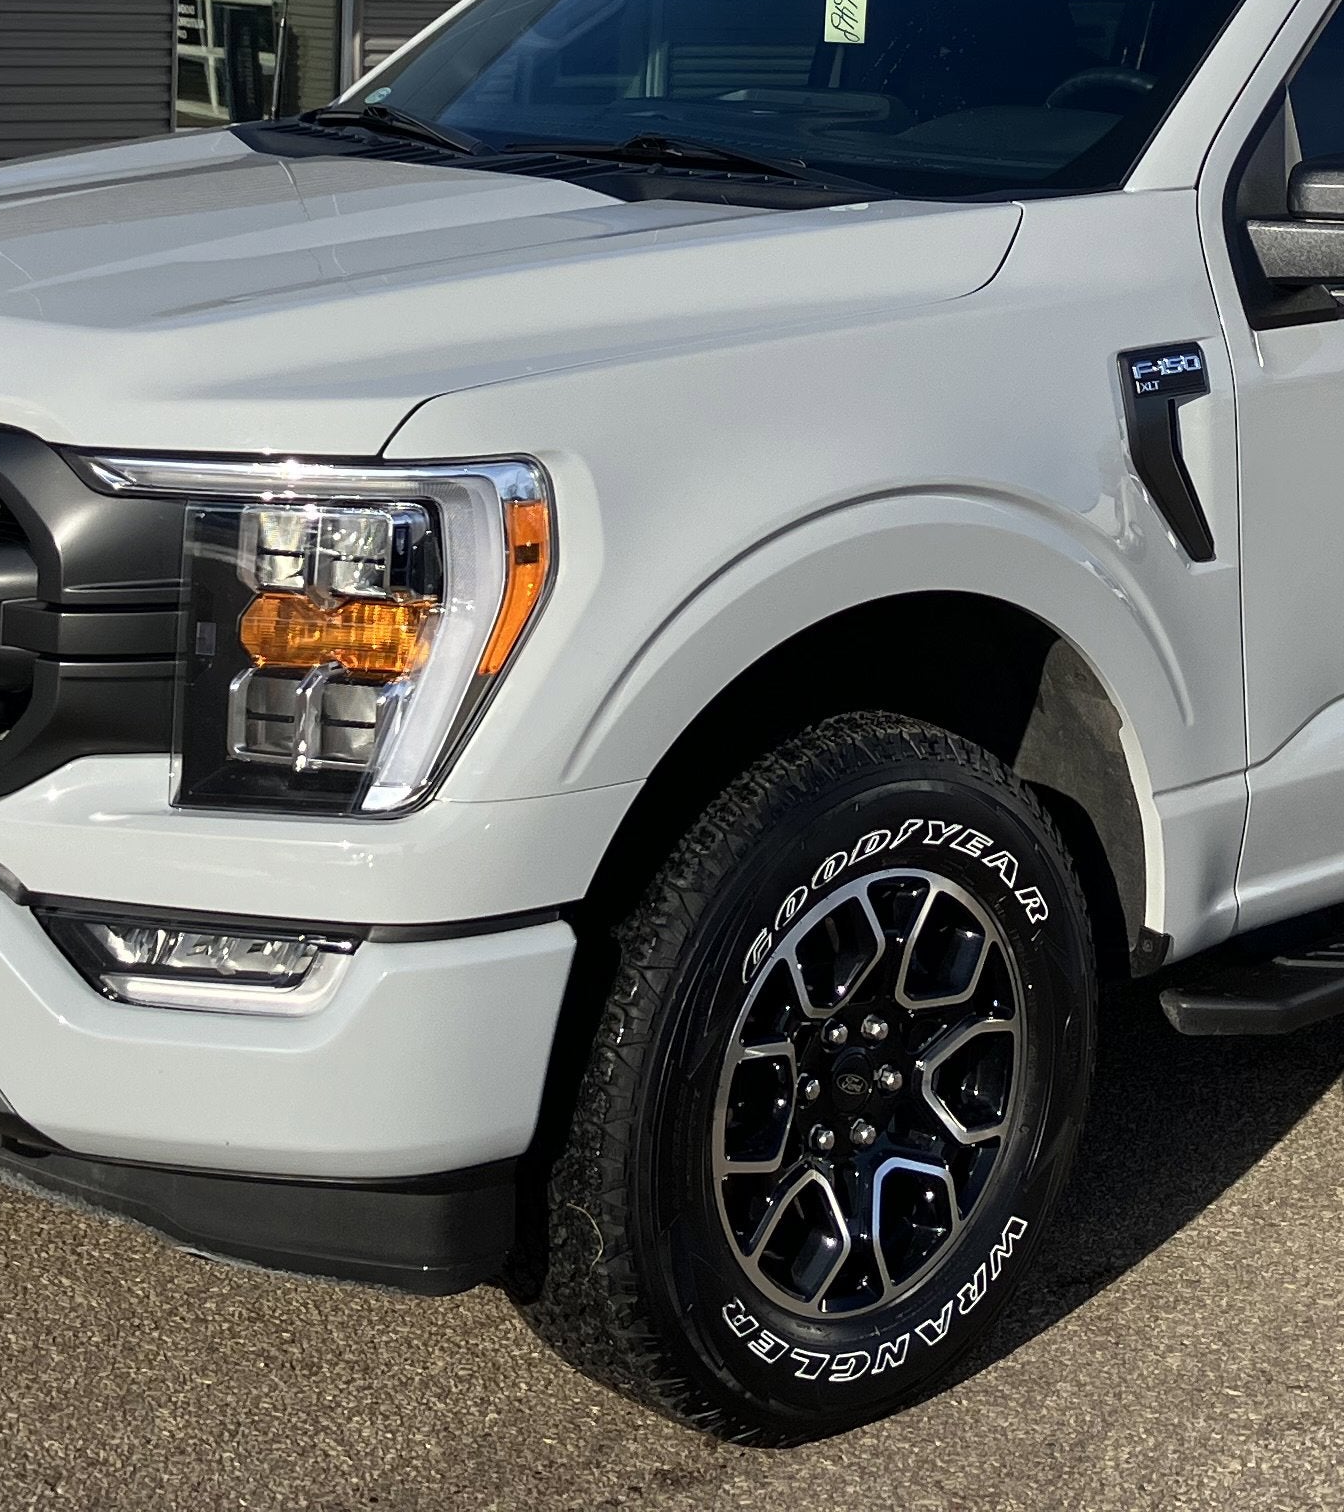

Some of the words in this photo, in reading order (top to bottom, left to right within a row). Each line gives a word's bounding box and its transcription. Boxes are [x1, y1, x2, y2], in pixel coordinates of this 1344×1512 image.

[1132, 355, 1201, 379] F-150
[1140, 380, 1160, 393] XLT
[742, 819, 1049, 984] GOODYEAR
[722, 1215, 1029, 1382] WRANGLER
